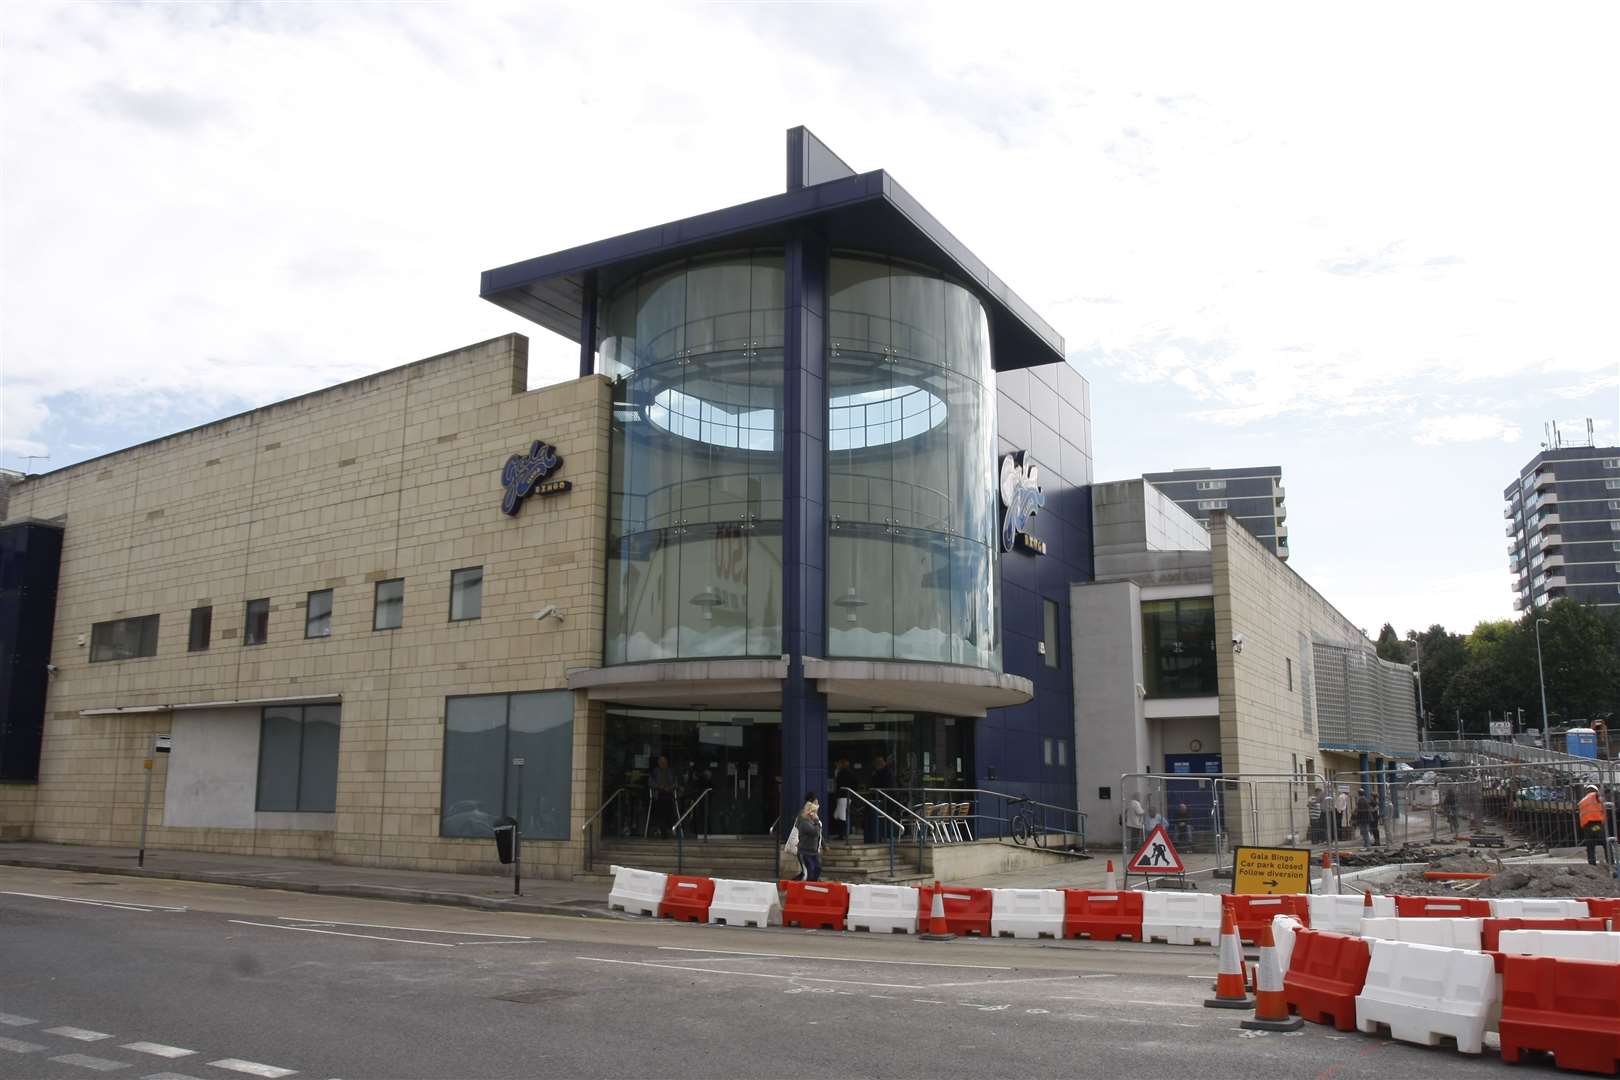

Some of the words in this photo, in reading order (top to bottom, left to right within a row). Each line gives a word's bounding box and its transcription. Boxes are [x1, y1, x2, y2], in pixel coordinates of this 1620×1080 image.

[535, 481, 567, 494] BINGO
[1250, 853, 1269, 861] Gala
[1271, 853, 1295, 863] Bingo
[1240, 860, 1254, 868] Car
[1257, 861, 1275, 869] park
[1277, 862, 1304, 871] closed
[1239, 868, 1265, 876] Follow
[1267, 870, 1304, 879] diversion
